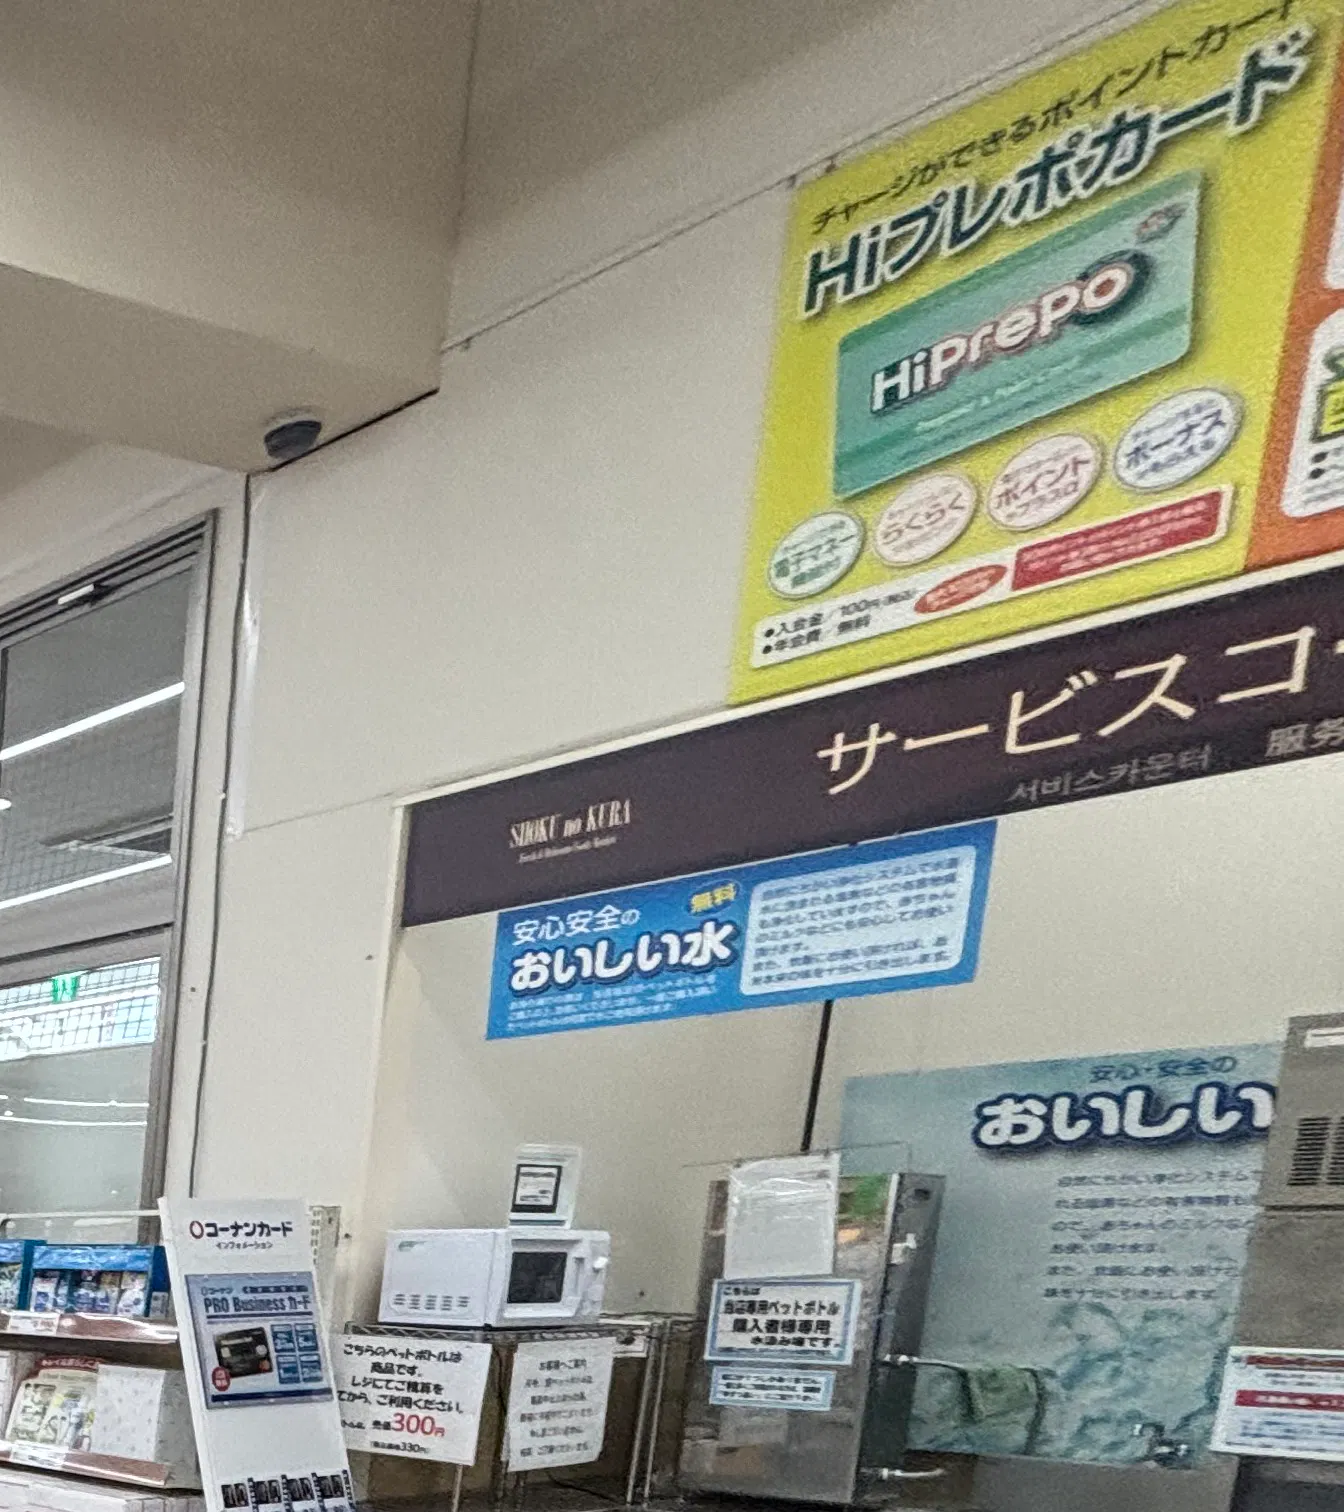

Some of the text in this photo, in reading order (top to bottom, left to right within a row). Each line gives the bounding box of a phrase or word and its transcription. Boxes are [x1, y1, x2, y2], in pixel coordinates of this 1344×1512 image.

[813, 0, 1298, 232] チャージができるポイントカード
[802, 28, 1311, 314] Hiプレポカード
[817, 626, 1344, 794] サービスコ
[1013, 746, 1211, 802] 서비스카운터
[514, 905, 640, 945] 安心安全の
[511, 921, 734, 991] おいしい水
[978, 1085, 1273, 1147] おいしい
[205, 1221, 293, 1237] コーナンカード
[204, 1297, 229, 1313] PRO
[233, 1296, 286, 1311] Business
[343, 1343, 463, 1363] こちらのペットボトルは
[370, 1361, 422, 1377] 商品です。
